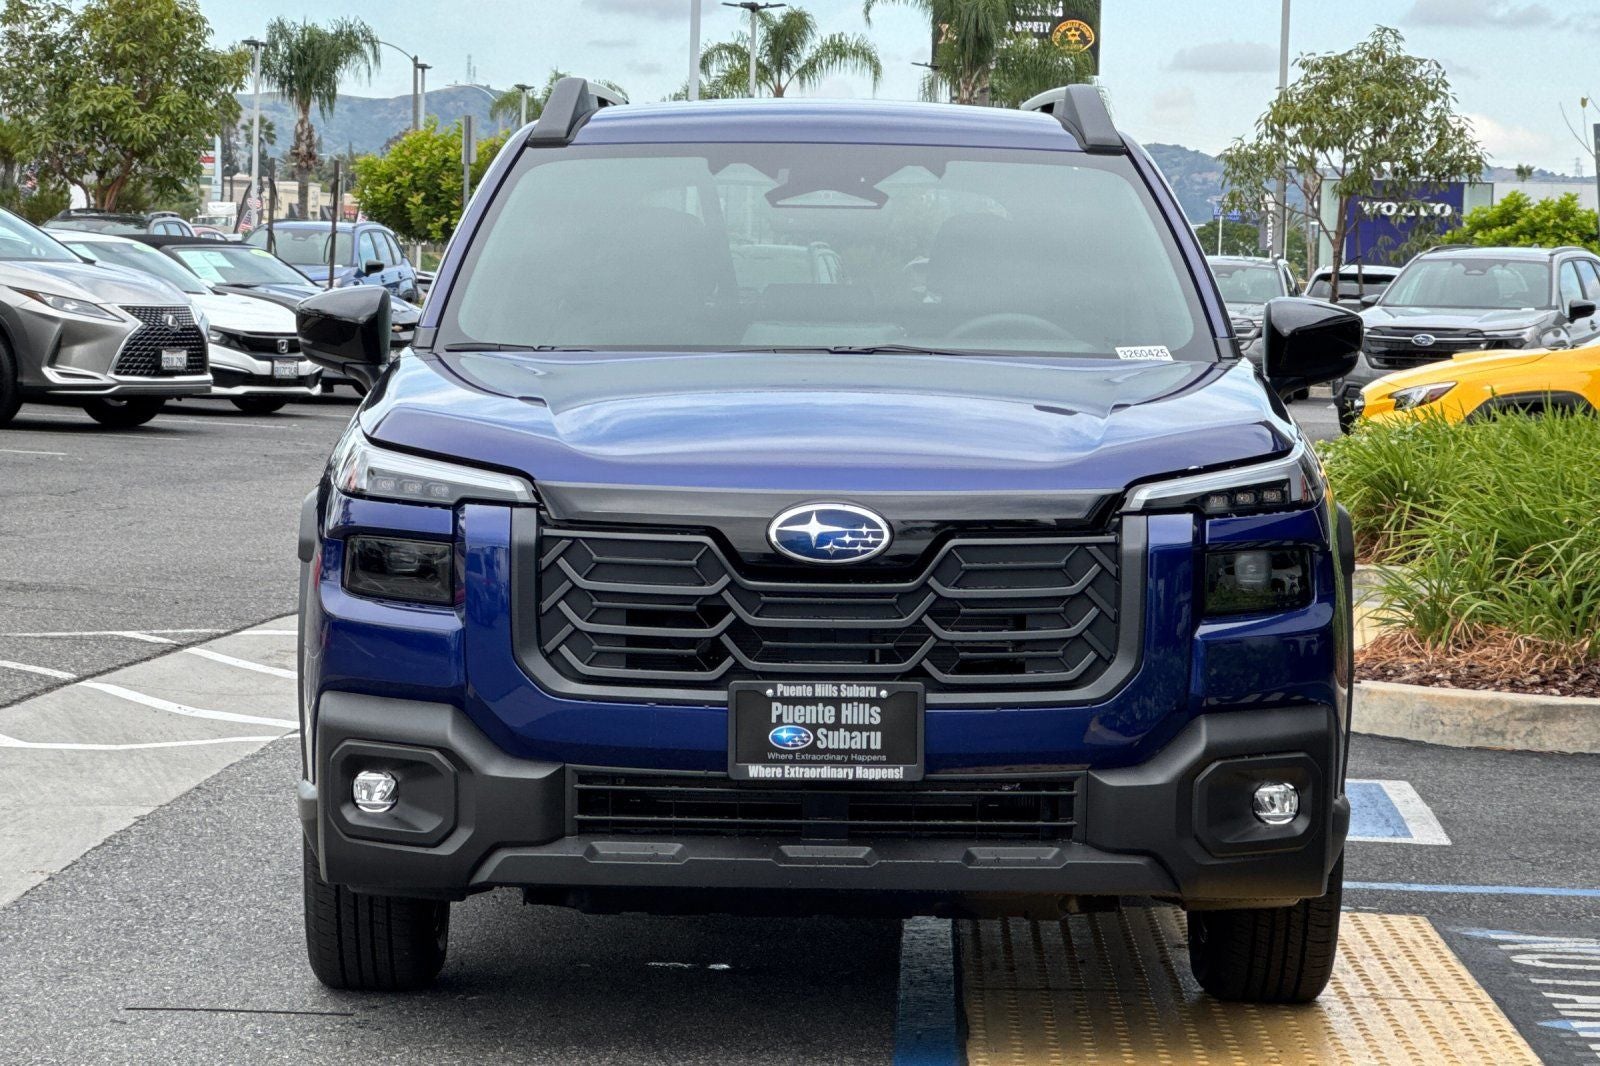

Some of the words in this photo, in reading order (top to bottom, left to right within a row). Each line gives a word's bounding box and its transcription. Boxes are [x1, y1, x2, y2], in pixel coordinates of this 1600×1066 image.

[1119, 348, 1169, 359] 3260425
[776, 683, 813, 697] Puente
[814, 683, 839, 698] Hills
[840, 683, 877, 698] Subaru
[771, 701, 836, 724] Puente
[841, 702, 882, 725] Hills
[816, 727, 882, 750] Subaru
[767, 752, 794, 760] Where
[795, 752, 849, 762] Extraordinary
[850, 753, 887, 762] Happens
[748, 765, 783, 778] Where
[784, 765, 854, 780] Extraordinary
[855, 766, 904, 780] Happens!
